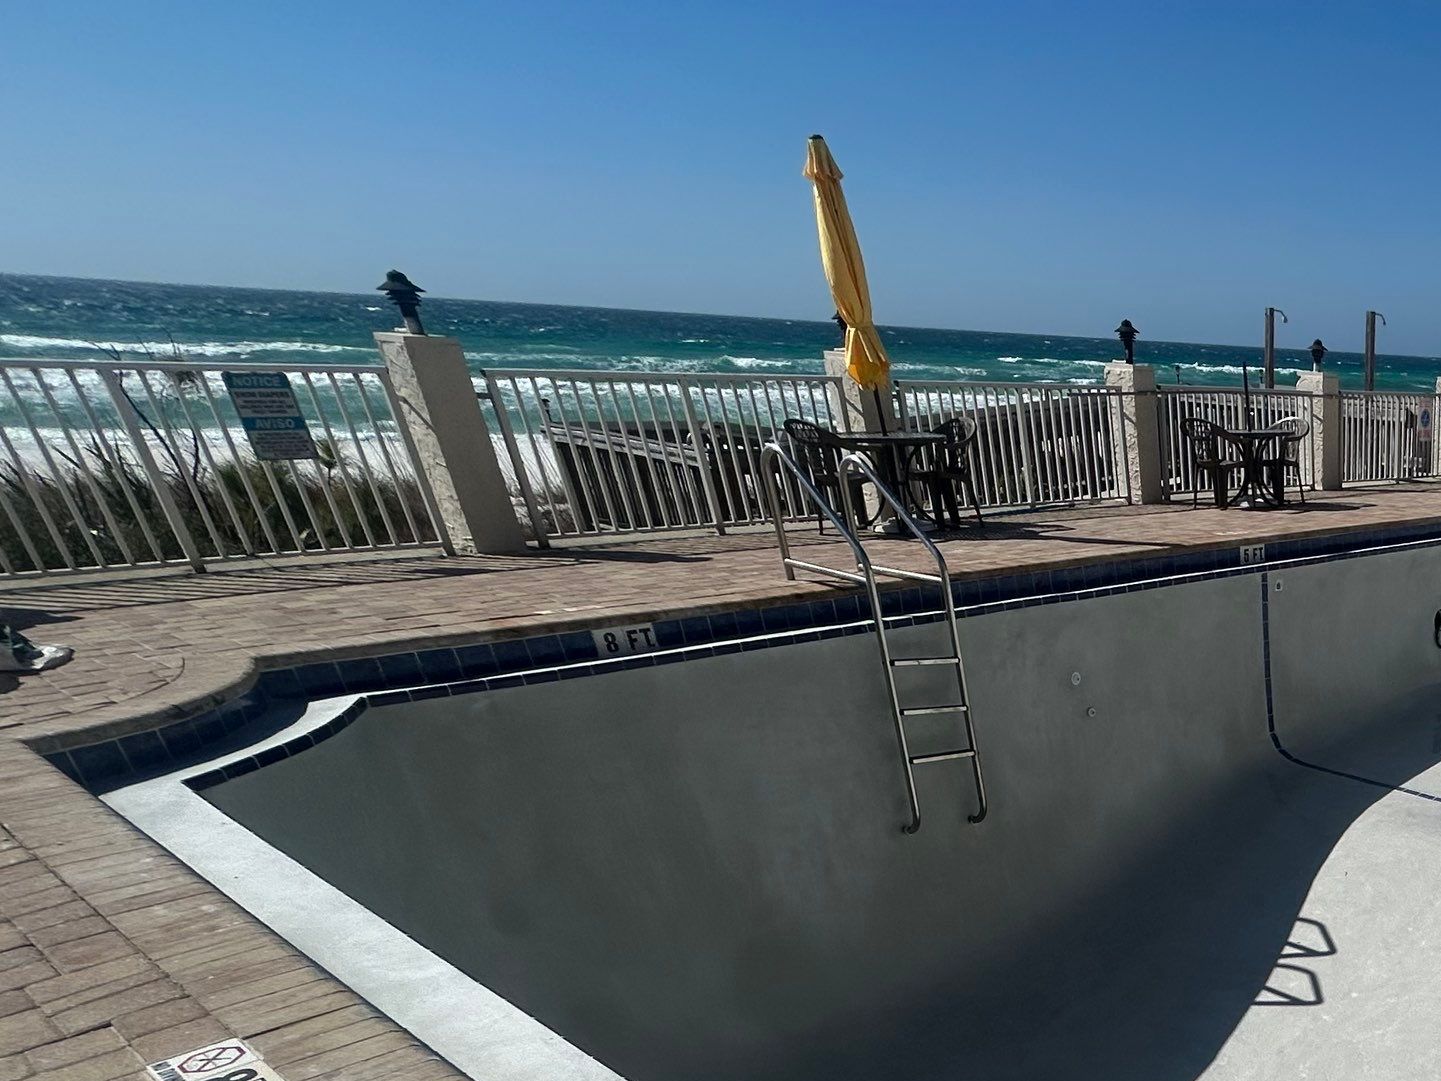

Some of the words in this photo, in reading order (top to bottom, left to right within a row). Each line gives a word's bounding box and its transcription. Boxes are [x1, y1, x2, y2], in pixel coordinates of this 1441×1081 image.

[232, 376, 282, 387] NOTICE
[255, 418, 296, 429] AVISO
[1244, 549, 1250, 562] 5
[603, 632, 620, 653] 8
